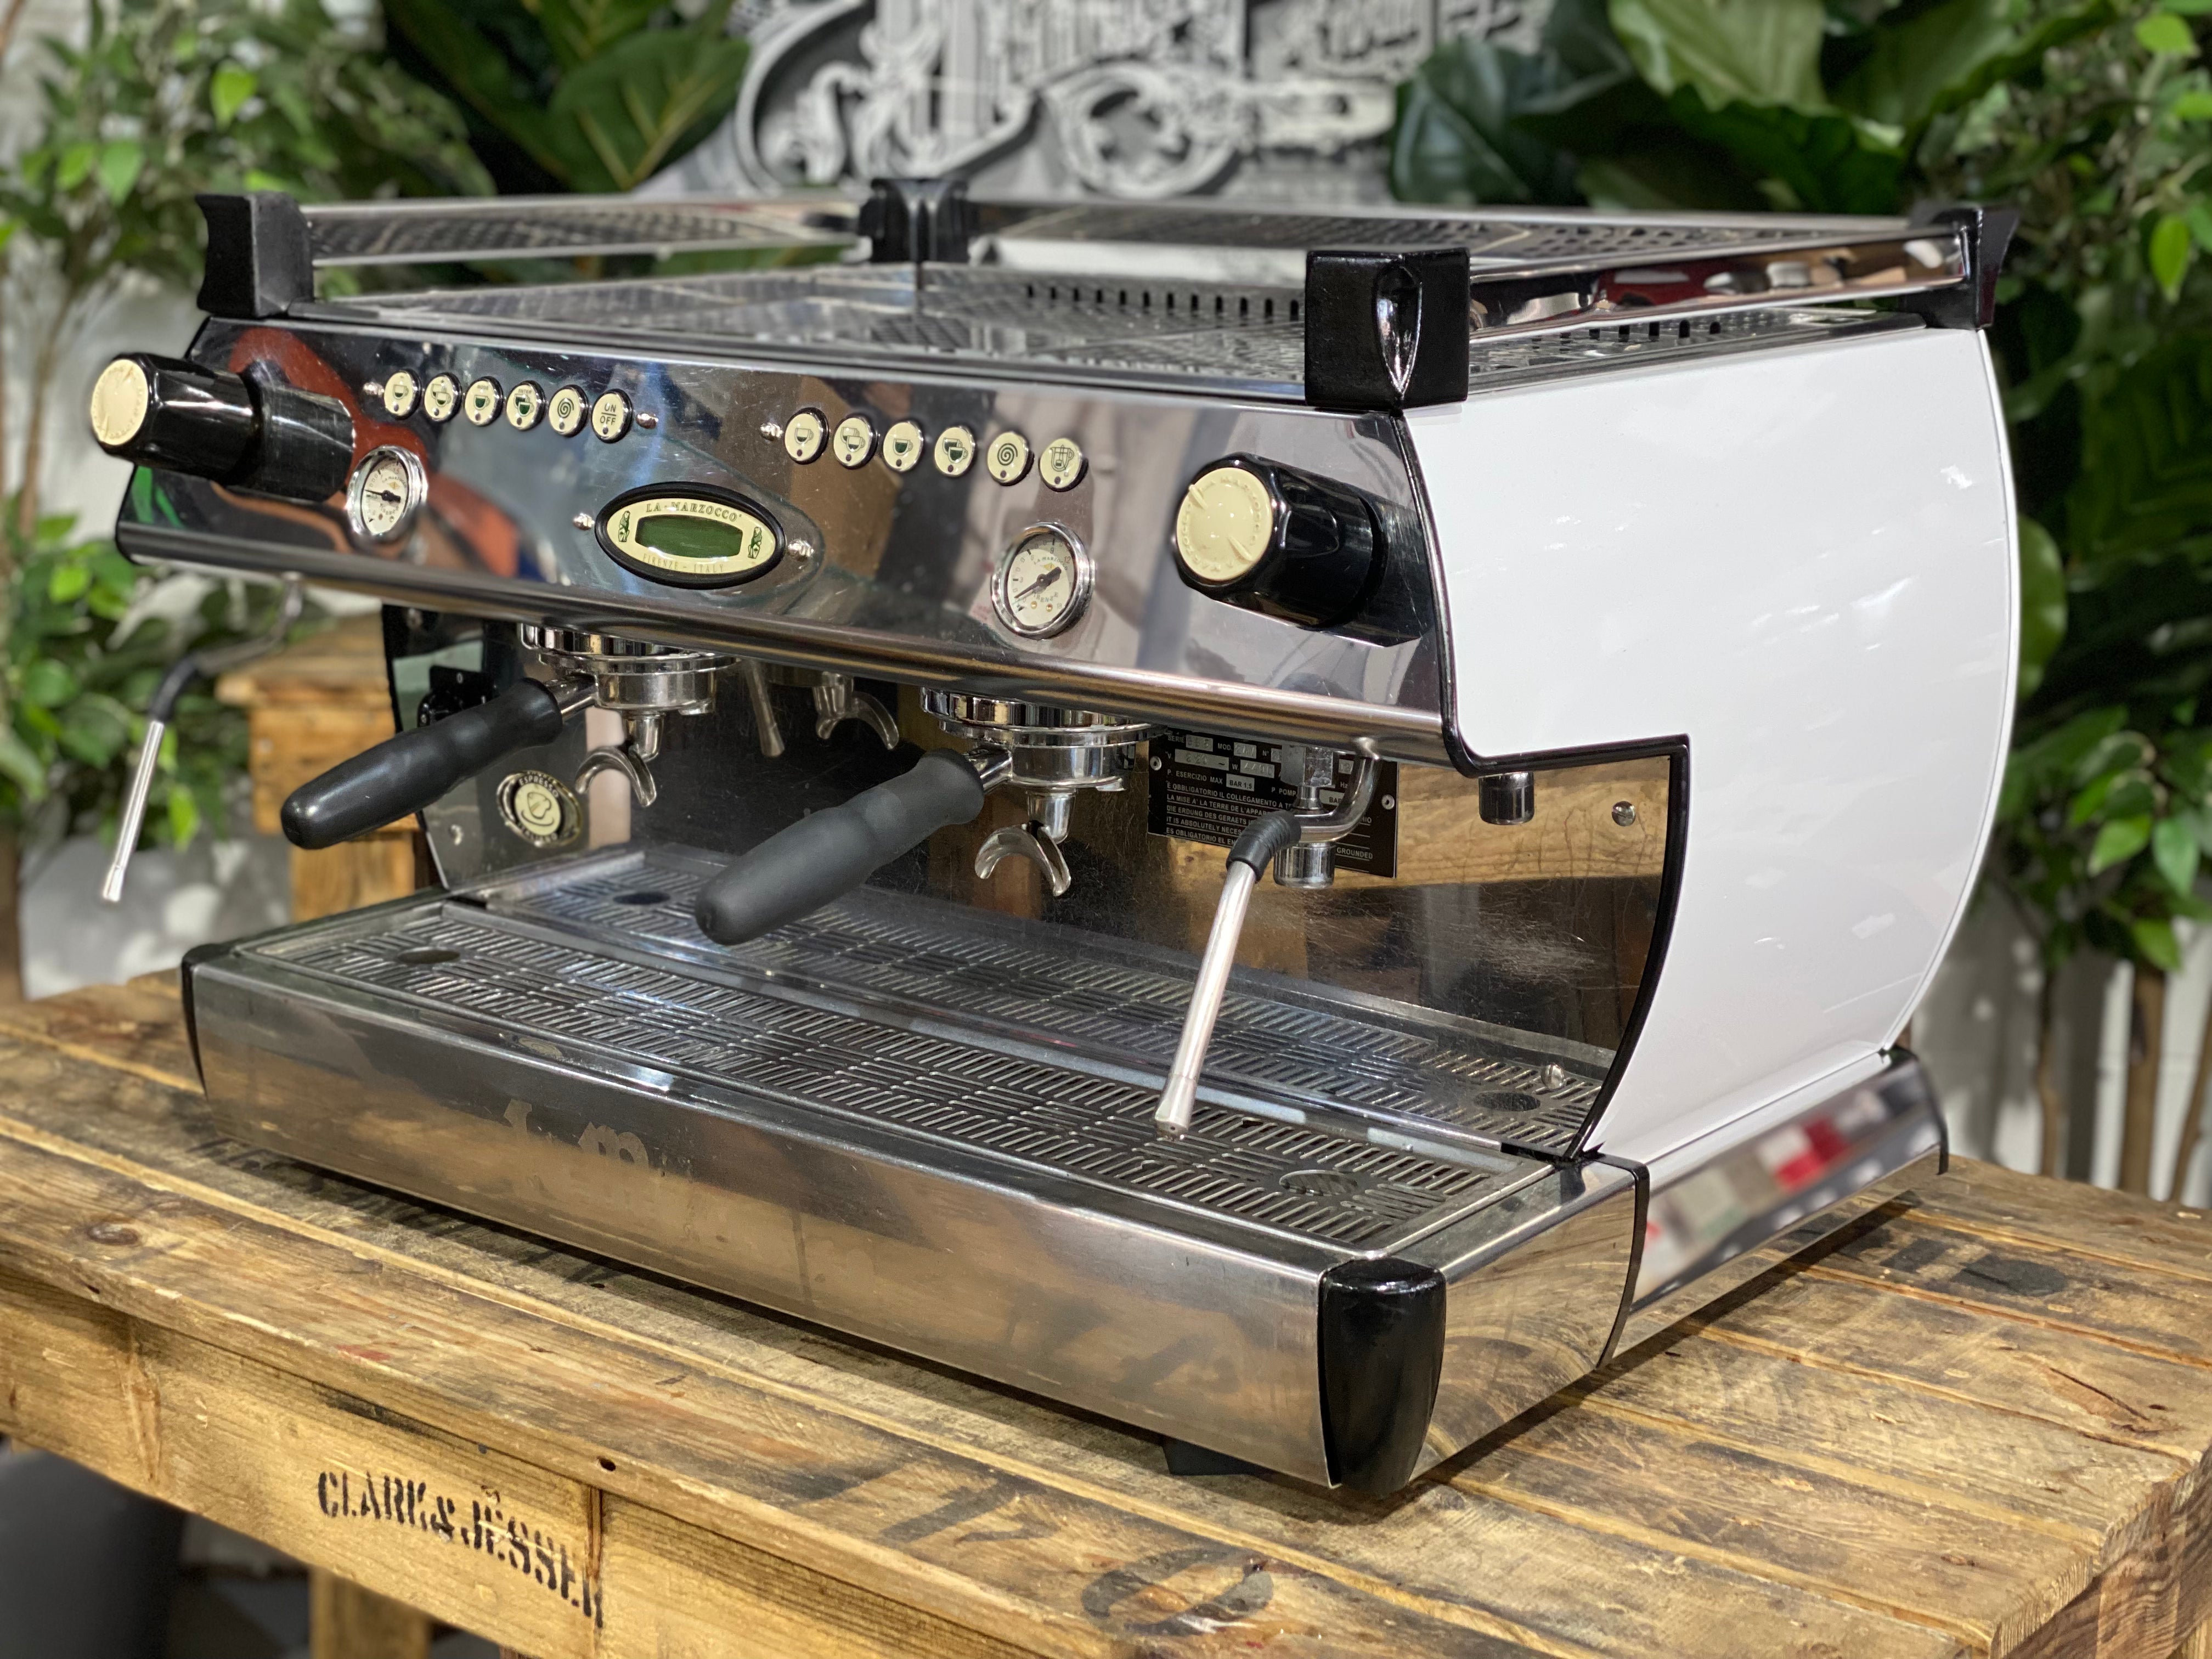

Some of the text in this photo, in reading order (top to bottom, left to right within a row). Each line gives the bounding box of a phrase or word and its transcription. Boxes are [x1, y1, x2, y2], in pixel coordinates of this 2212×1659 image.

[604, 403, 616, 413] ON
[600, 416, 616, 426] OFF
[646, 501, 737, 521] LA MARZOCCO
[643, 553, 679, 570] FIRENZE
[694, 563, 724, 573] ITALY
[519, 775, 559, 798] ESPRESSO
[1176, 770, 1207, 782] ESERCIZIO
[1210, 776, 1223, 785] MAX
[1279, 788, 1296, 797] POMP
[1172, 783, 1218, 797] OBBLIGATORIO
[1226, 793, 1277, 808] COLLEGAMENTO
[1178, 807, 1203, 817] ERDUNG
[1218, 814, 1247, 825] GERAETS
[1209, 801, 1229, 810] TERRE
[1240, 807, 1268, 816] L'APPAR
[1176, 829, 1217, 842] OBLIGATORIO
[1180, 819, 1220, 831] ABSOLUTELY
[1221, 826, 1242, 834] NECES
[1336, 847, 1373, 860] GROUNDED
[318, 1471, 427, 1532] CLARK
